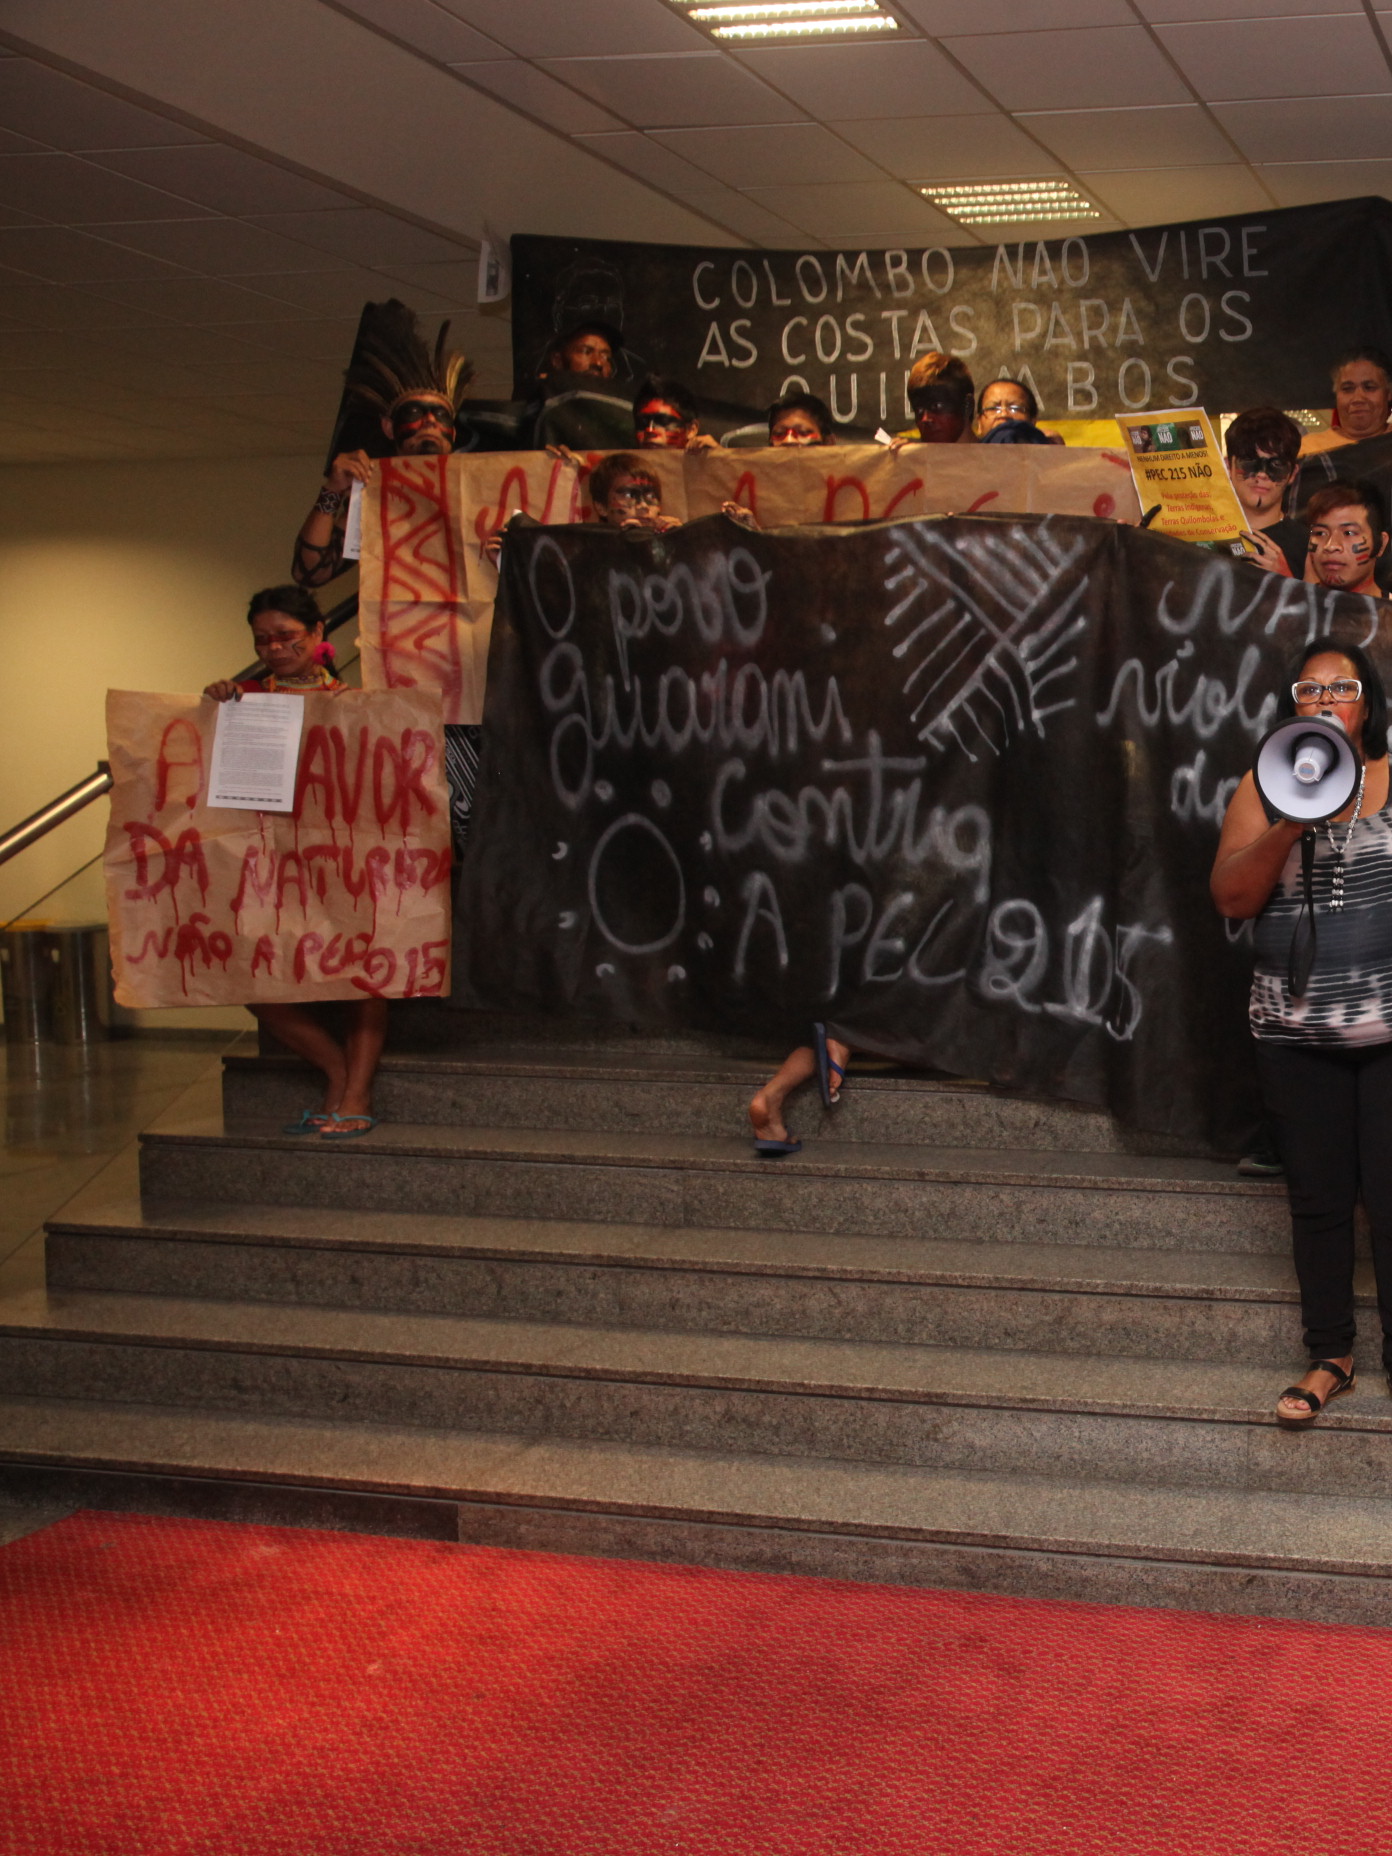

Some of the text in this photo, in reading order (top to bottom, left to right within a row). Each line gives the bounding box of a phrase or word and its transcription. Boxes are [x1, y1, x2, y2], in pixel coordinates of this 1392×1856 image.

[692, 246, 955, 311] COLOMBO
[1129, 226, 1269, 283] VIRE
[697, 290, 1254, 370] AS COSTAS PARA OS
[1145, 462, 1213, 481] #PEC 215 NÃO
[1167, 504, 1184, 513] Terras
[1161, 518, 1180, 526] Terras
[1180, 514, 1218, 525] Quilombolas
[1195, 524, 1237, 536] Conservação
[528, 535, 771, 692] O povo
[155, 718, 205, 812] A
[293, 722, 437, 823] AVOR
[122, 821, 209, 903] DA
[126, 912, 232, 970] NÃO
[251, 934, 275, 976] A
[734, 871, 788, 980] A
[823, 881, 967, 1002] PEC
